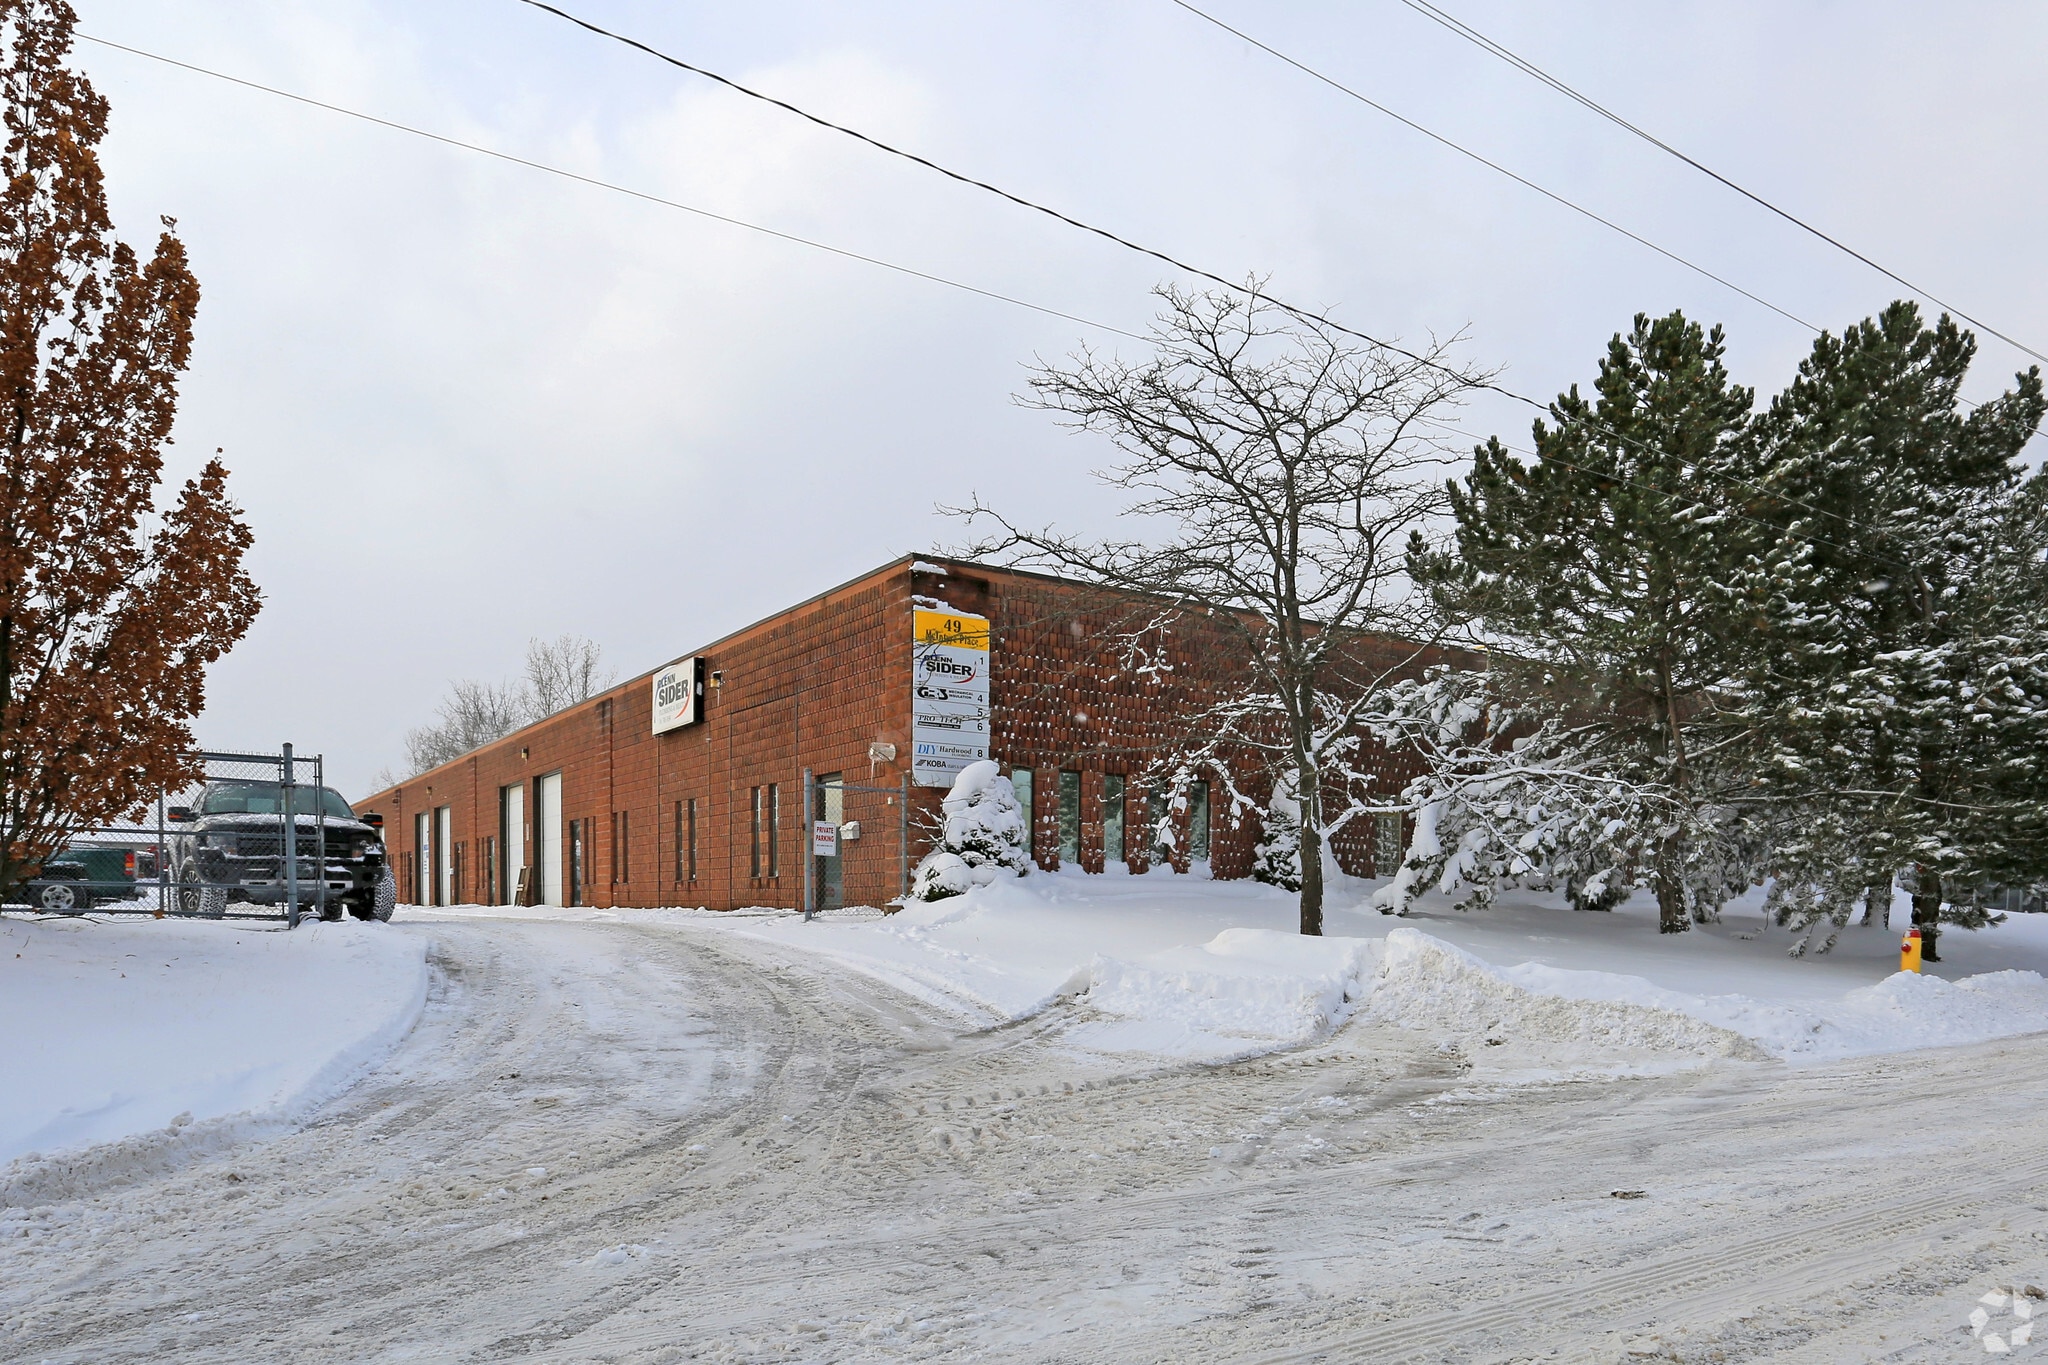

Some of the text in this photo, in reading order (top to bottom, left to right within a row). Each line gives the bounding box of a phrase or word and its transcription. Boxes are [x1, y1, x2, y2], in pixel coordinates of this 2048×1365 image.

[944, 619, 961, 633] 49
[980, 657, 984, 665] 1
[926, 661, 973, 676] SIDER
[659, 680, 688, 707] SIDER
[977, 694, 983, 703] 4
[977, 708, 983, 717] 5
[977, 722, 983, 731] 6
[917, 744, 972, 755] DIY Hardwood
[977, 749, 983, 758] 8
[926, 760, 947, 769] KOBA
